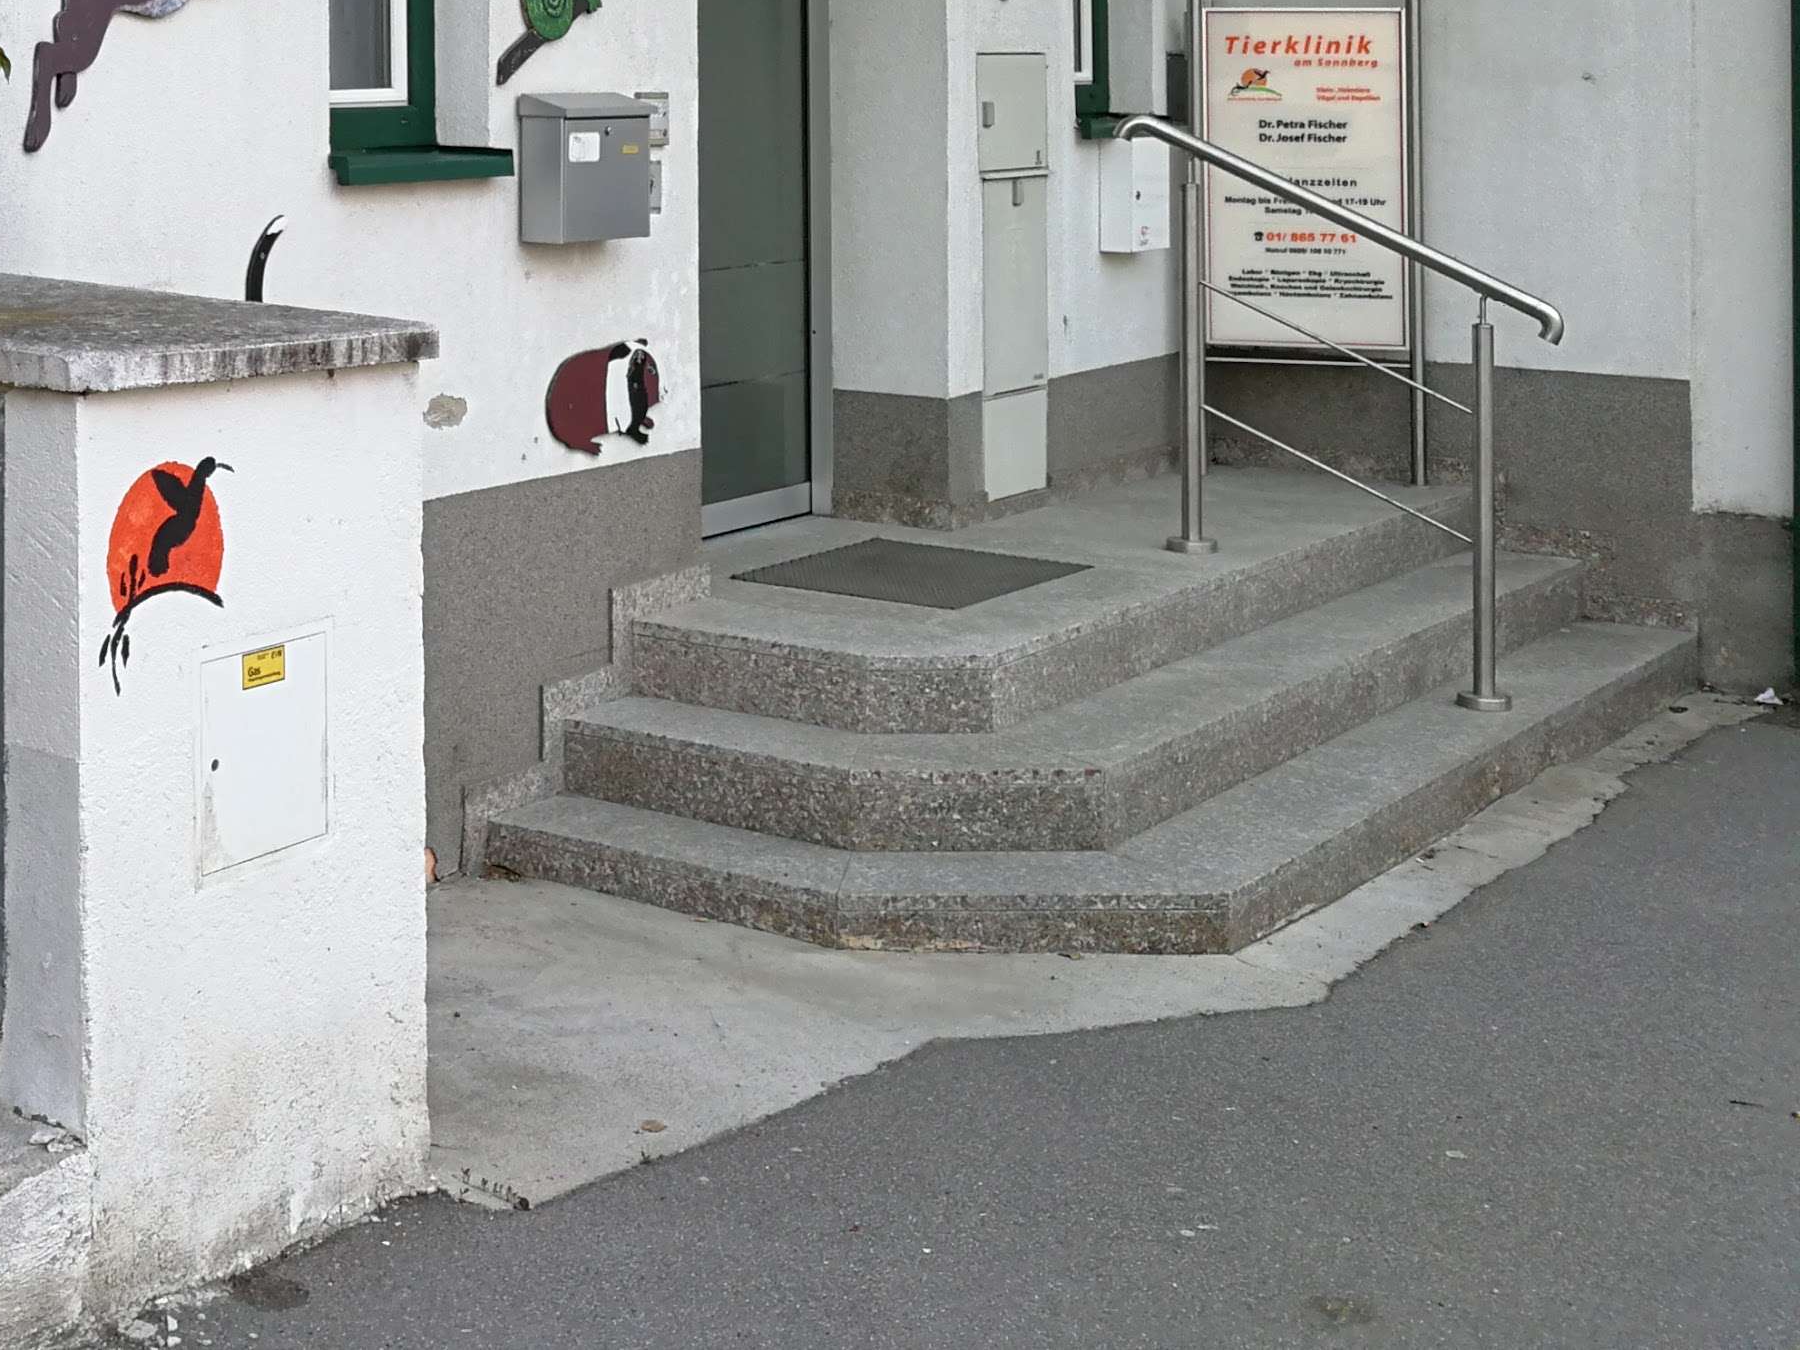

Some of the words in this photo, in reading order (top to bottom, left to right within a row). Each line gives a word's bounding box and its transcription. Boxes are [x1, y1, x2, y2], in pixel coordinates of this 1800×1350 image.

[1225, 35, 1372, 55] Tierklinik
[1294, 59, 1312, 67] am
[1317, 58, 1379, 69] Sonnberg
[1258, 120, 1275, 129] Dr.
[1276, 120, 1305, 129] Petra
[1307, 120, 1348, 130] Fischer
[1258, 133, 1275, 143] Dr.
[1276, 133, 1305, 143] Josef
[1307, 133, 1348, 143] Fischer
[1319, 234, 1336, 243] 77
[248, 666, 261, 677] Gas
